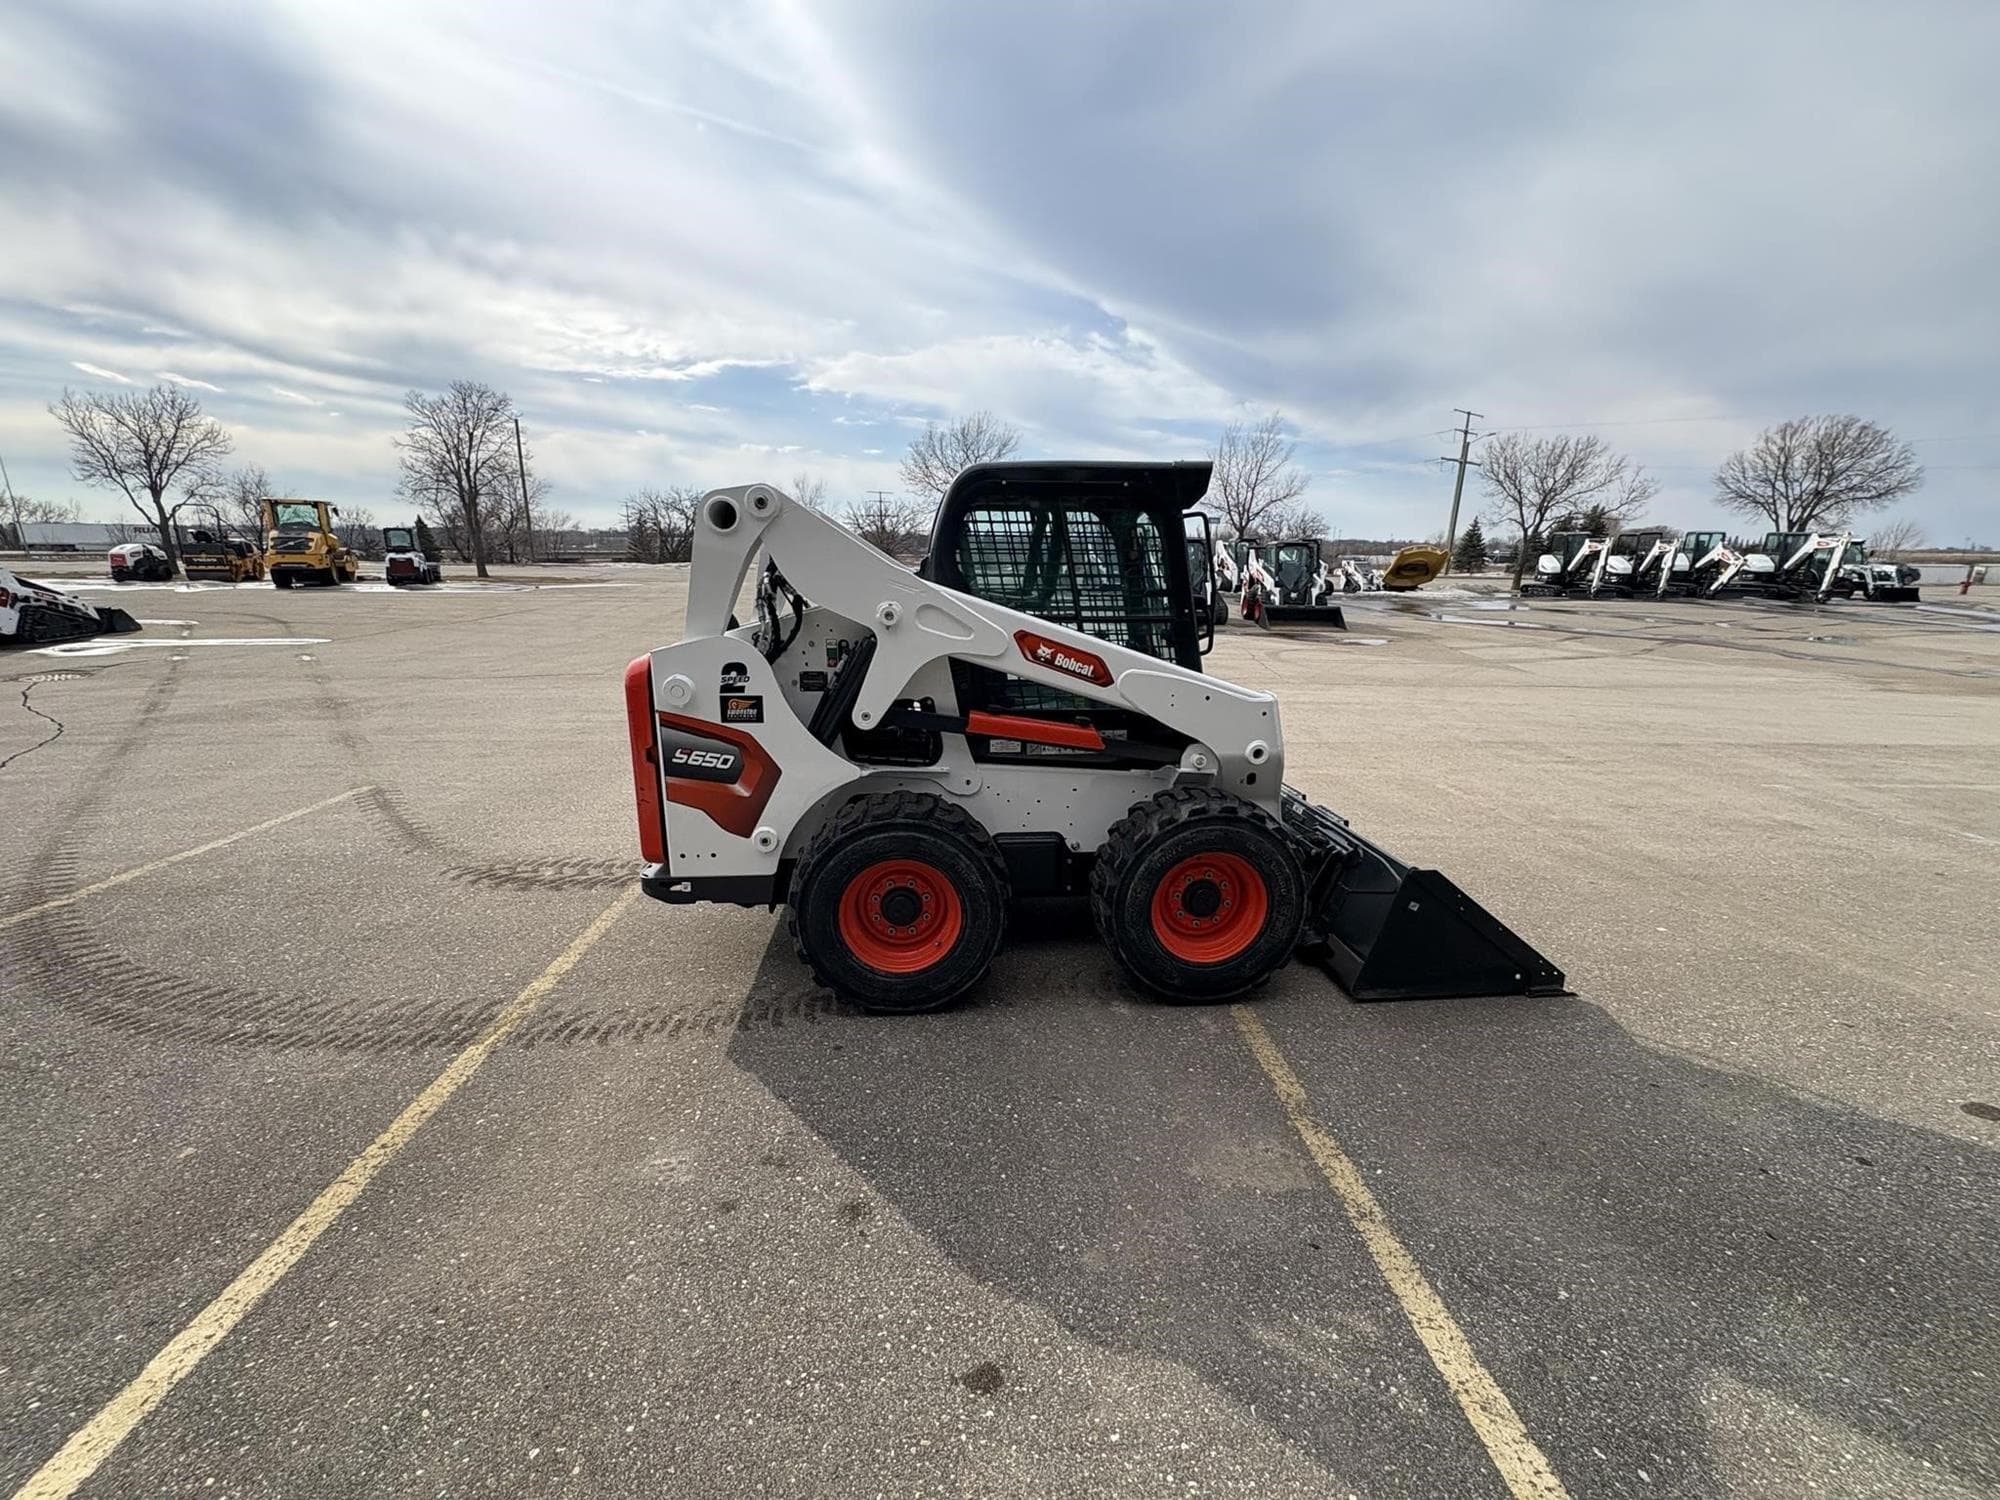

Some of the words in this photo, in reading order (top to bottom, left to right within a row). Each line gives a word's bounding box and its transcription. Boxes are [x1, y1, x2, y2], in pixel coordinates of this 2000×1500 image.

[1054, 652, 1094, 677] Bobcat
[720, 662, 748, 693] 2
[720, 675, 750, 683] SPEED
[672, 748, 735, 769] S650
